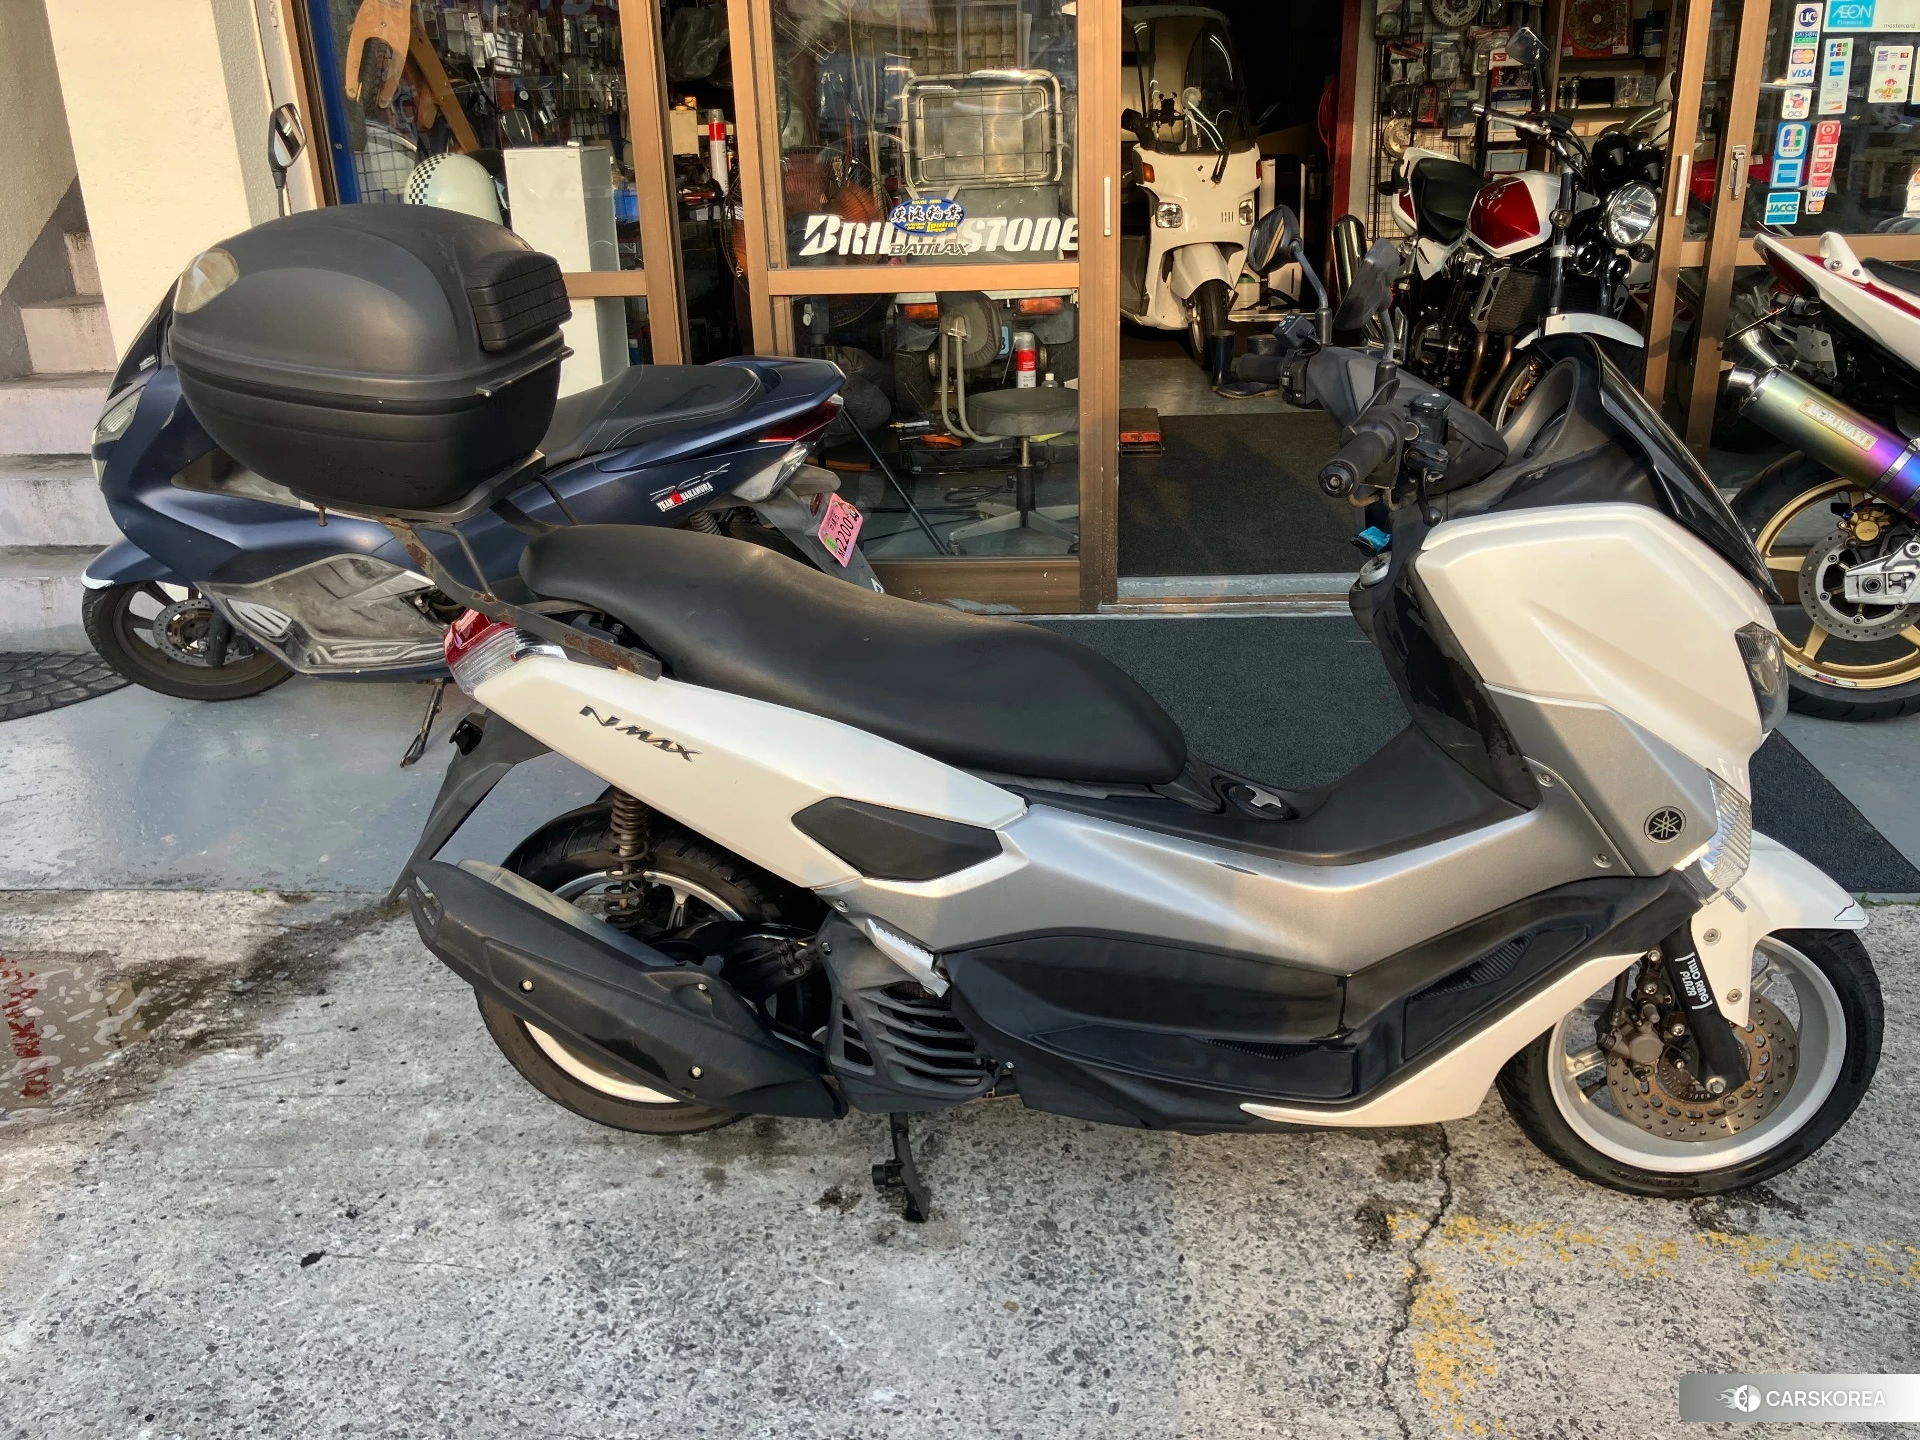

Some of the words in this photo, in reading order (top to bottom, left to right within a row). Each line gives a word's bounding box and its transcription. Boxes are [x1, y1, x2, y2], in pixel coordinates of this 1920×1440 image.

[1792, 69, 1813, 78] VISA
[1767, 203, 1798, 213] JACCS
[799, 215, 1079, 256] BRIDSTONE
[889, 242, 969, 256] BATTLAX
[1806, 402, 1870, 447] MORIWAKI
[836, 517, 854, 553] 2200
[579, 704, 703, 762] NMAX
[1680, 971, 1697, 997] PLAZA
[1687, 958, 1701, 980] TWO
[1695, 980, 1709, 1002] RING
